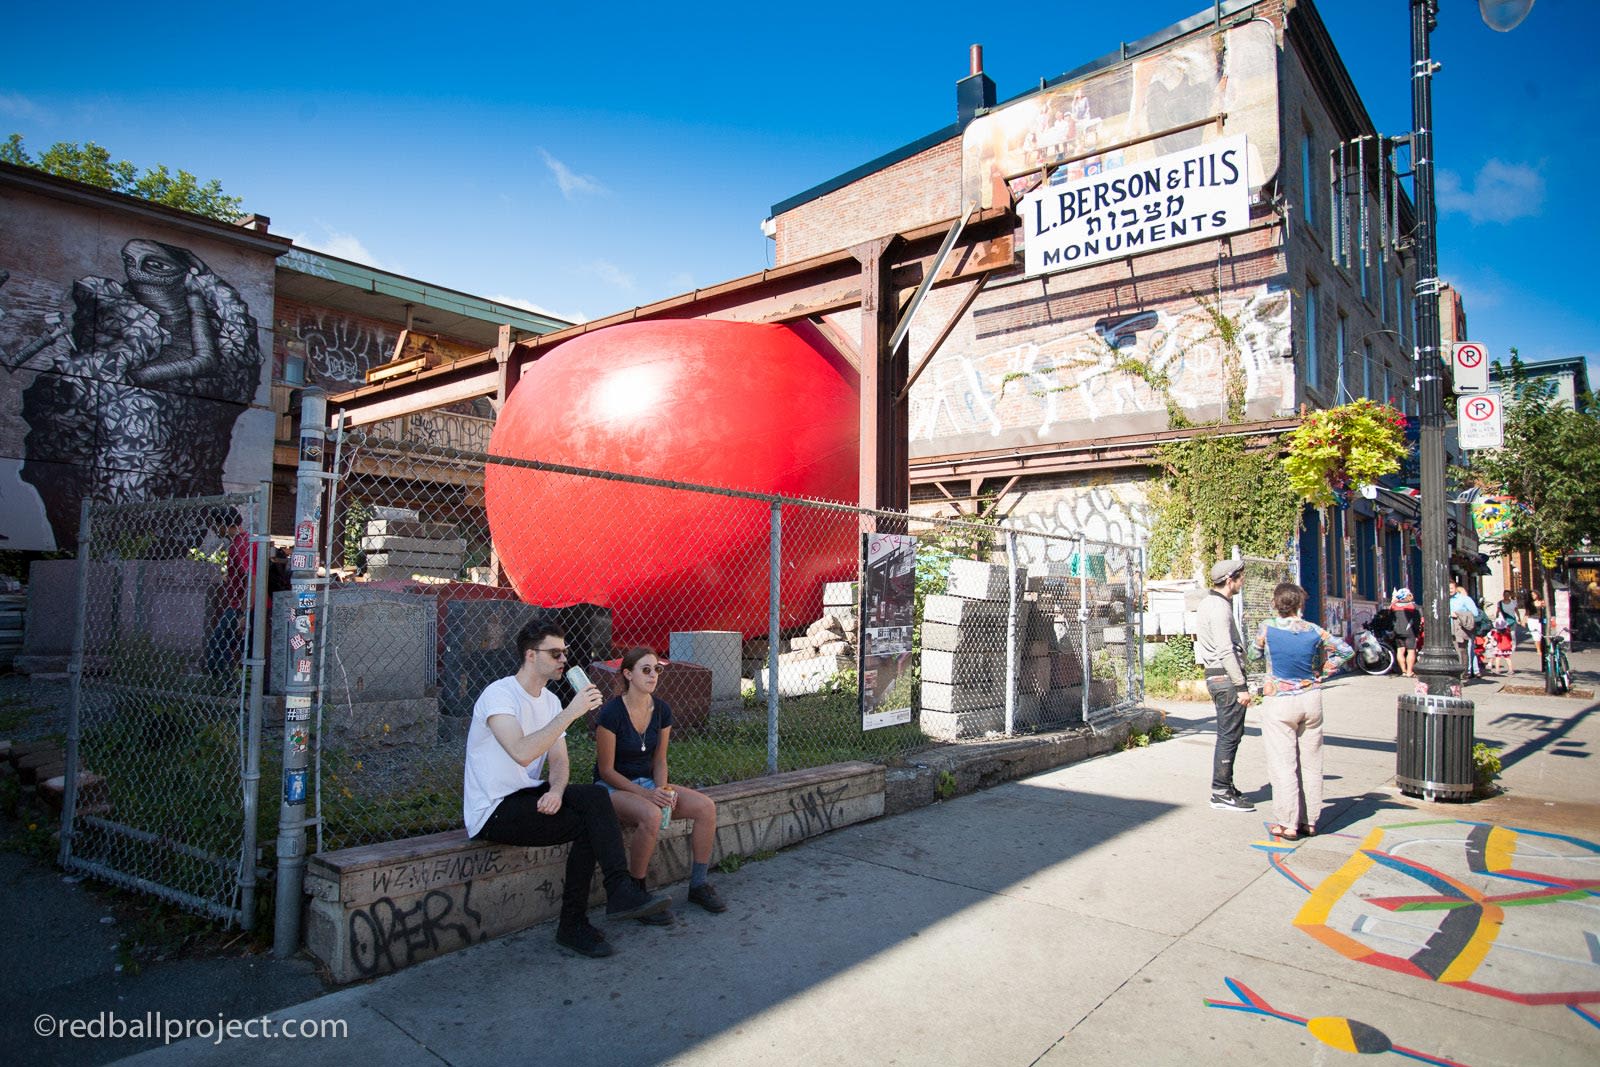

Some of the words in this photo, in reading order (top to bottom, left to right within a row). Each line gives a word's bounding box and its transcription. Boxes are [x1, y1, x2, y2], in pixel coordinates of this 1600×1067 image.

[1185, 150, 1240, 188] FILS
[1086, 195, 1184, 236] מצבות
[1043, 210, 1227, 266] MONUMENTS
